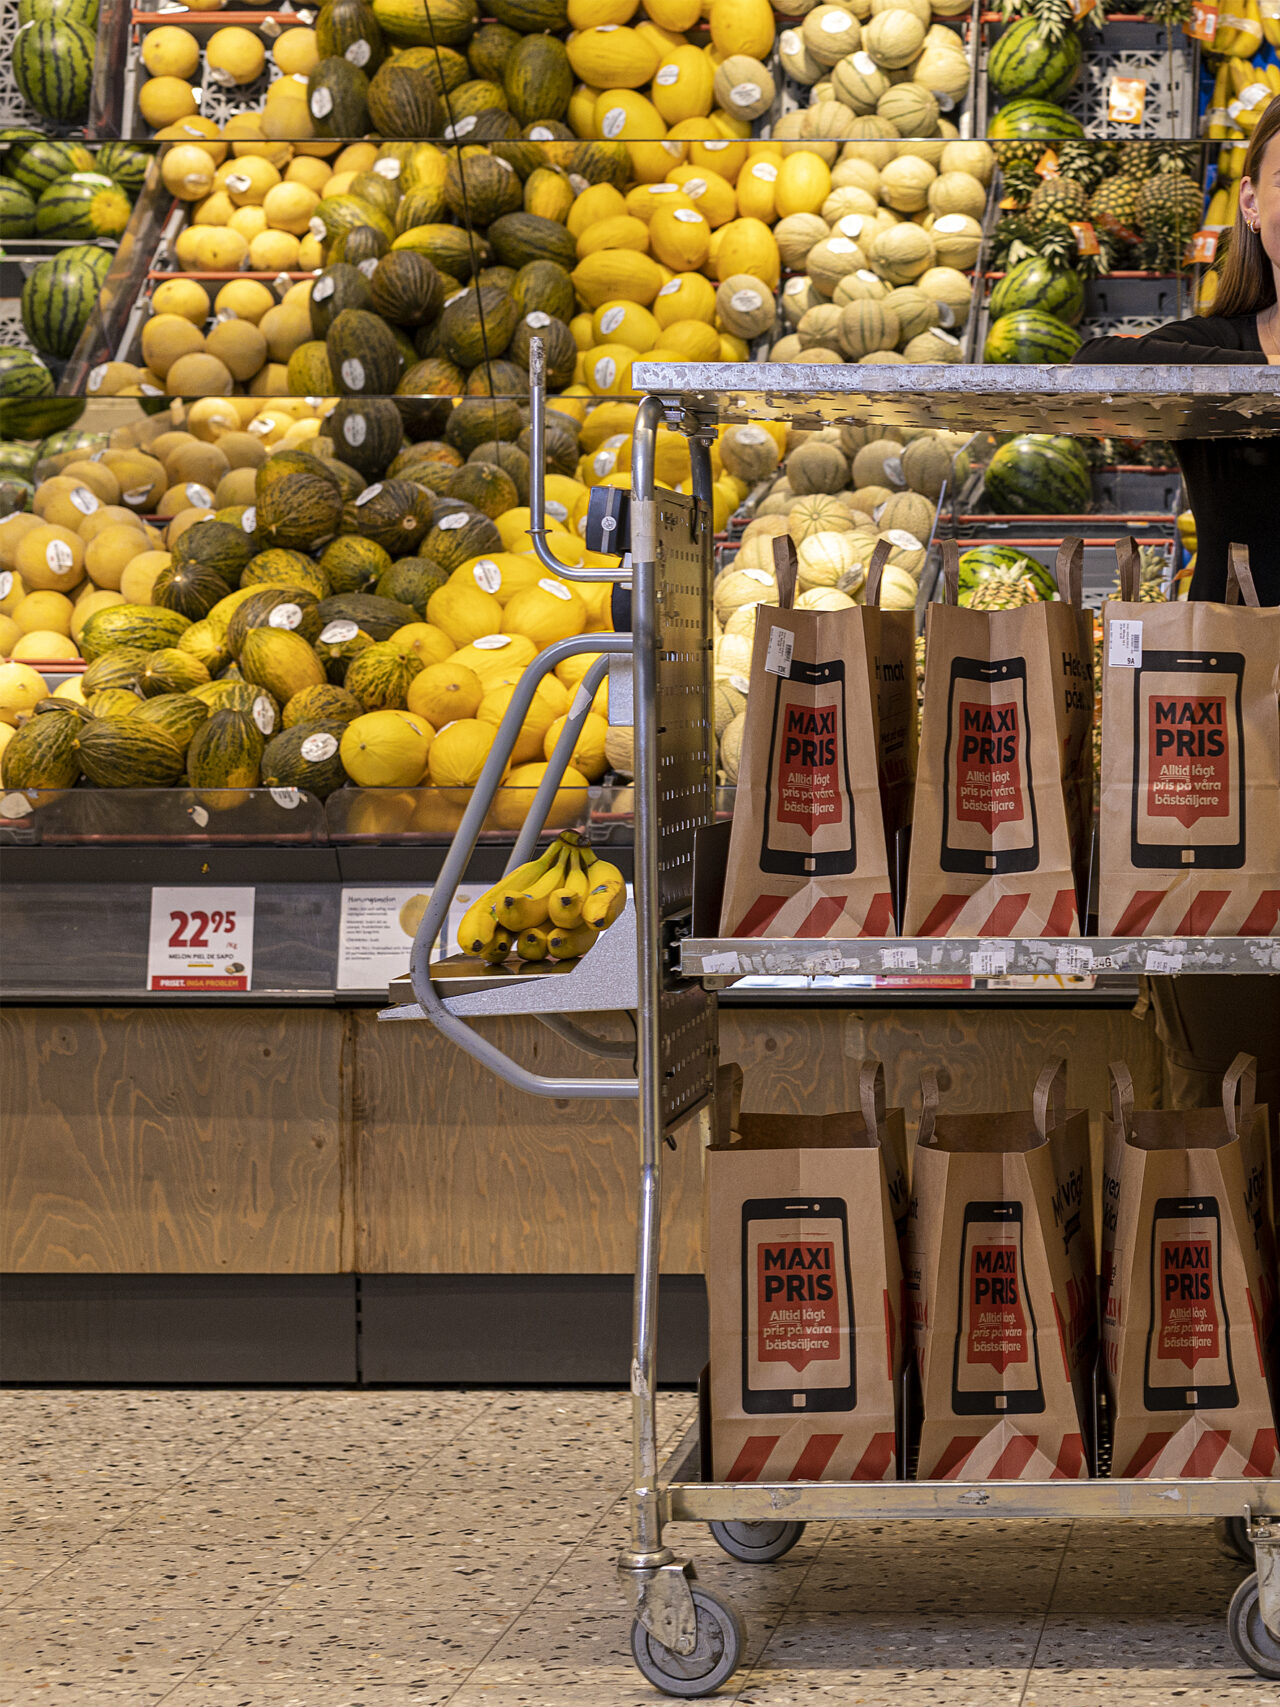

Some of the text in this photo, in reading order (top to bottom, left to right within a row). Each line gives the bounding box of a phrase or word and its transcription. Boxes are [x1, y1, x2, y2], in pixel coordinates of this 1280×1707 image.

[1156, 702, 1222, 724] MAXI
[787, 710, 835, 736] MAXI
[964, 709, 1015, 732] MAXI
[962, 735, 1016, 764] PRIS
[1156, 729, 1224, 757] PRIS
[785, 738, 836, 766] PRIS
[966, 771, 1010, 784] Alltid lågt
[1160, 764, 1214, 778] Alltid lågt
[787, 772, 829, 785] Alltid lågt
[1154, 778, 1221, 792] pris på våra
[783, 786, 834, 800] pris på våra
[961, 785, 1015, 798] pris på våra
[962, 800, 1014, 813] bästsäljare
[1156, 794, 1218, 807] bästsäljare
[784, 800, 834, 816] bästsäljare
[764, 1248, 829, 1270] MAXI
[976, 1252, 1016, 1274] MAXI
[1165, 1247, 1209, 1270] MAXI
[765, 1274, 833, 1302] PRIS
[975, 1278, 1017, 1305] PRIS
[1166, 1273, 1210, 1301] PRIS
[770, 1309, 825, 1322] Alltid lågt
[1170, 1307, 1207, 1320] Alltid lågt
[763, 1324, 832, 1337] pris på våra
[972, 1328, 989, 1339] pris
[1005, 1327, 1022, 1336] våra
[1164, 1324, 1180, 1336] pris
[1195, 1322, 1213, 1332] våra
[766, 1339, 829, 1352] bästsäljare
[974, 1341, 1021, 1354] bästsäljare
[1164, 1337, 1212, 1349] bästsäljare
